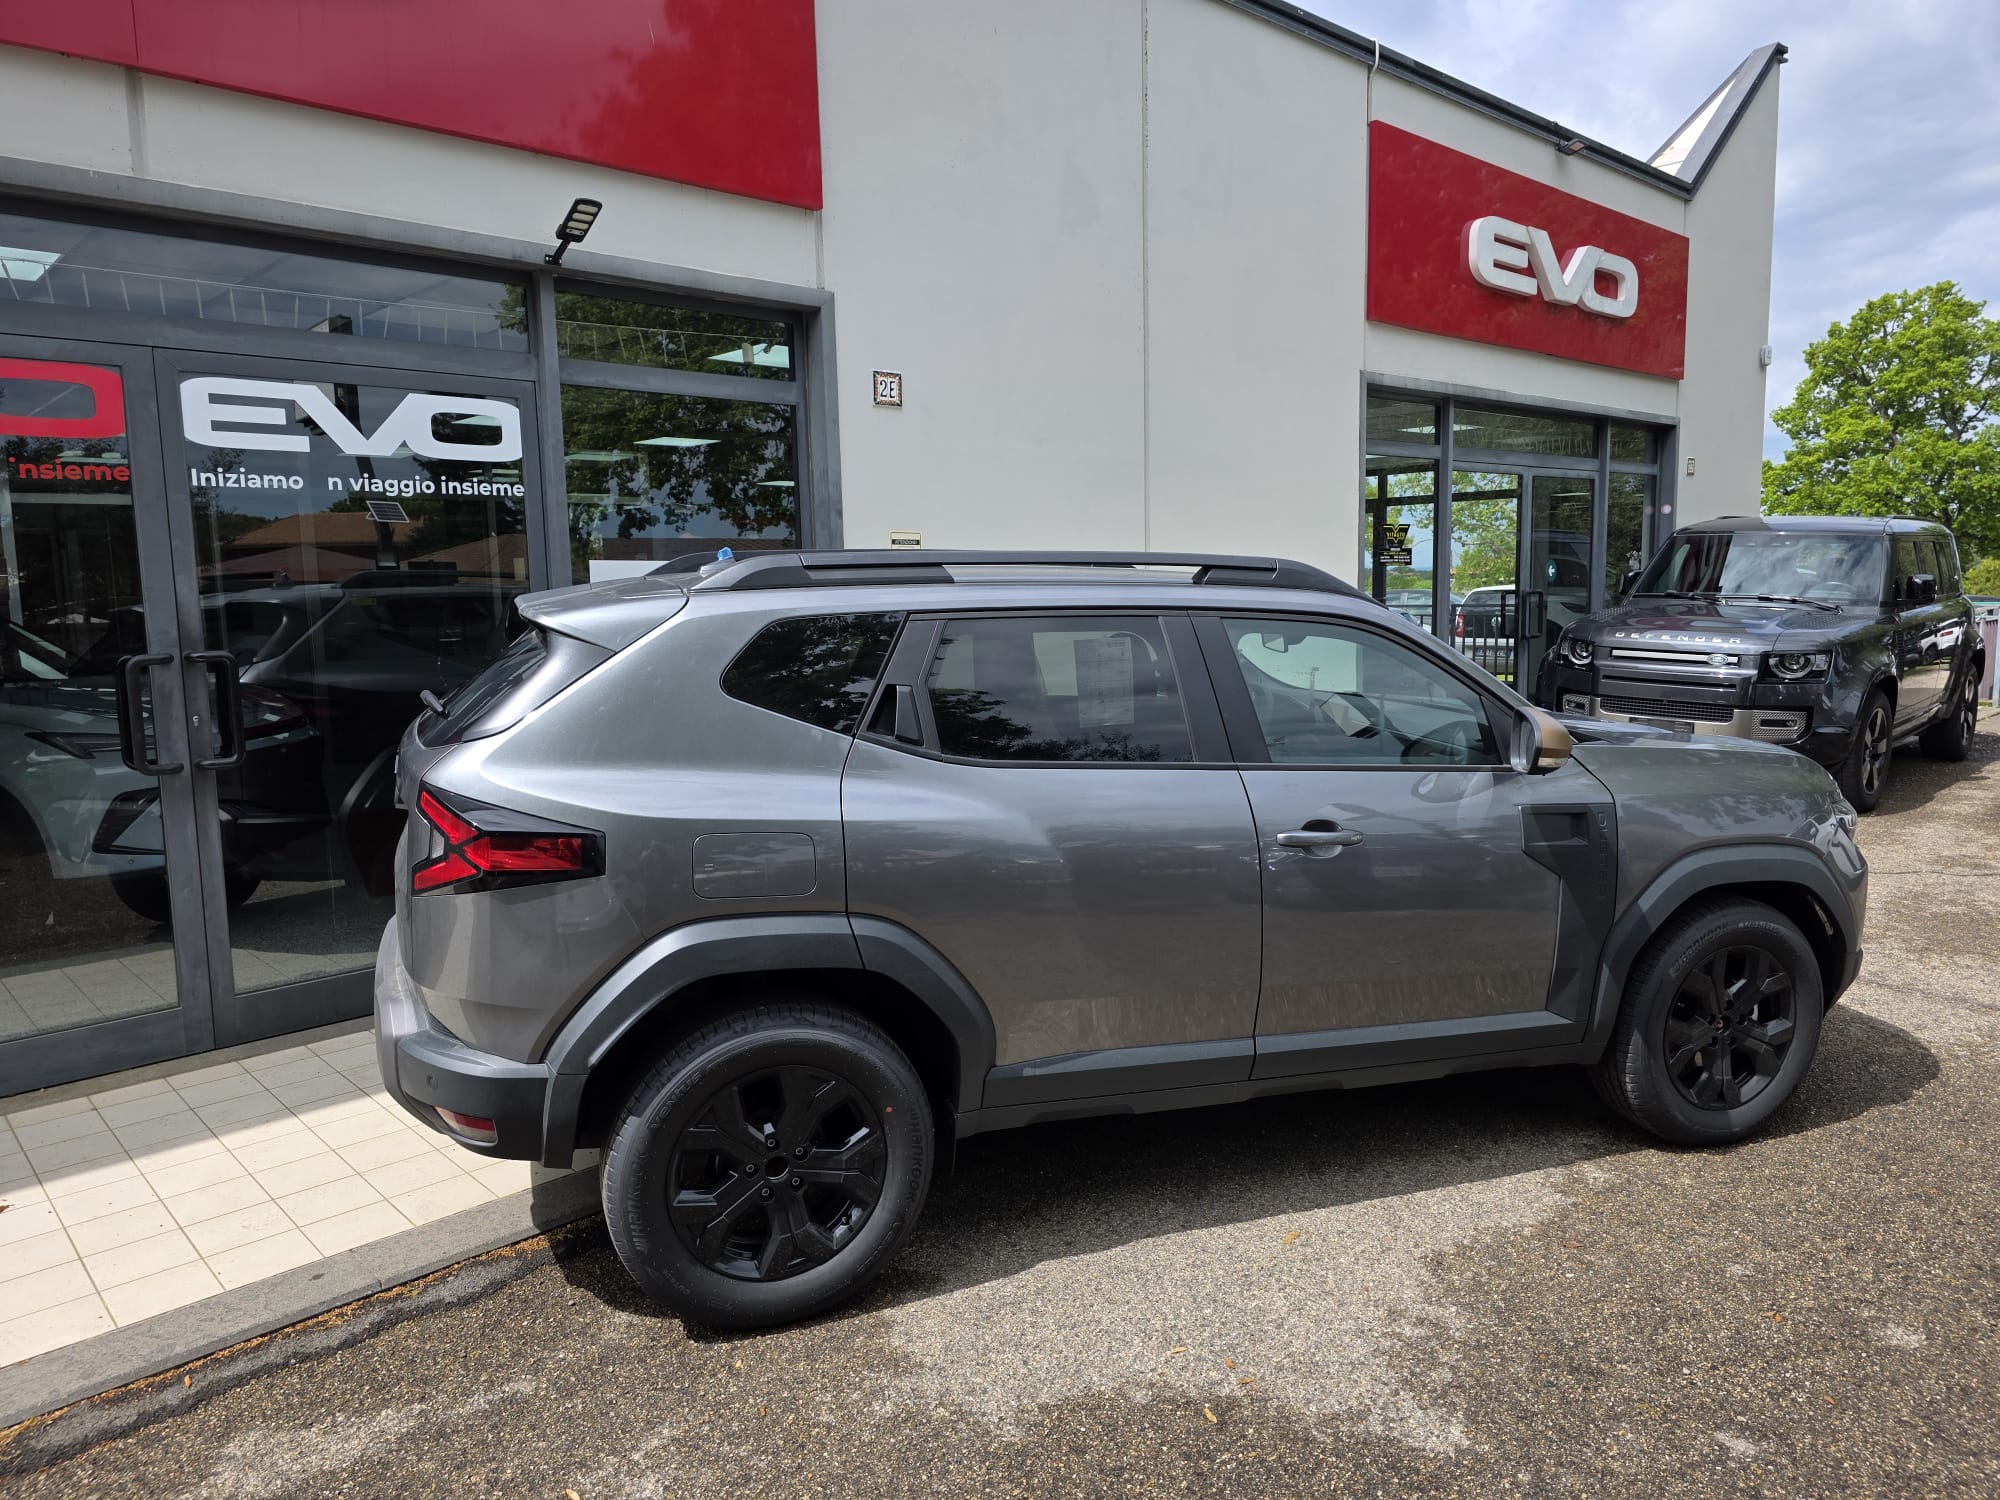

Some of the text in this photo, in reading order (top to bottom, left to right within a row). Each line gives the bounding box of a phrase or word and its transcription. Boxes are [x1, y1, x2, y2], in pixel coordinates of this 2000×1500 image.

[1469, 215, 1639, 318] EVO
[880, 379, 896, 399] 2E
[180, 376, 523, 462] EVO
[190, 467, 304, 490] Iniziamo
[349, 473, 436, 497] viaggio
[440, 475, 526, 497] insieme
[1615, 631, 1741, 644] DEFENDER
